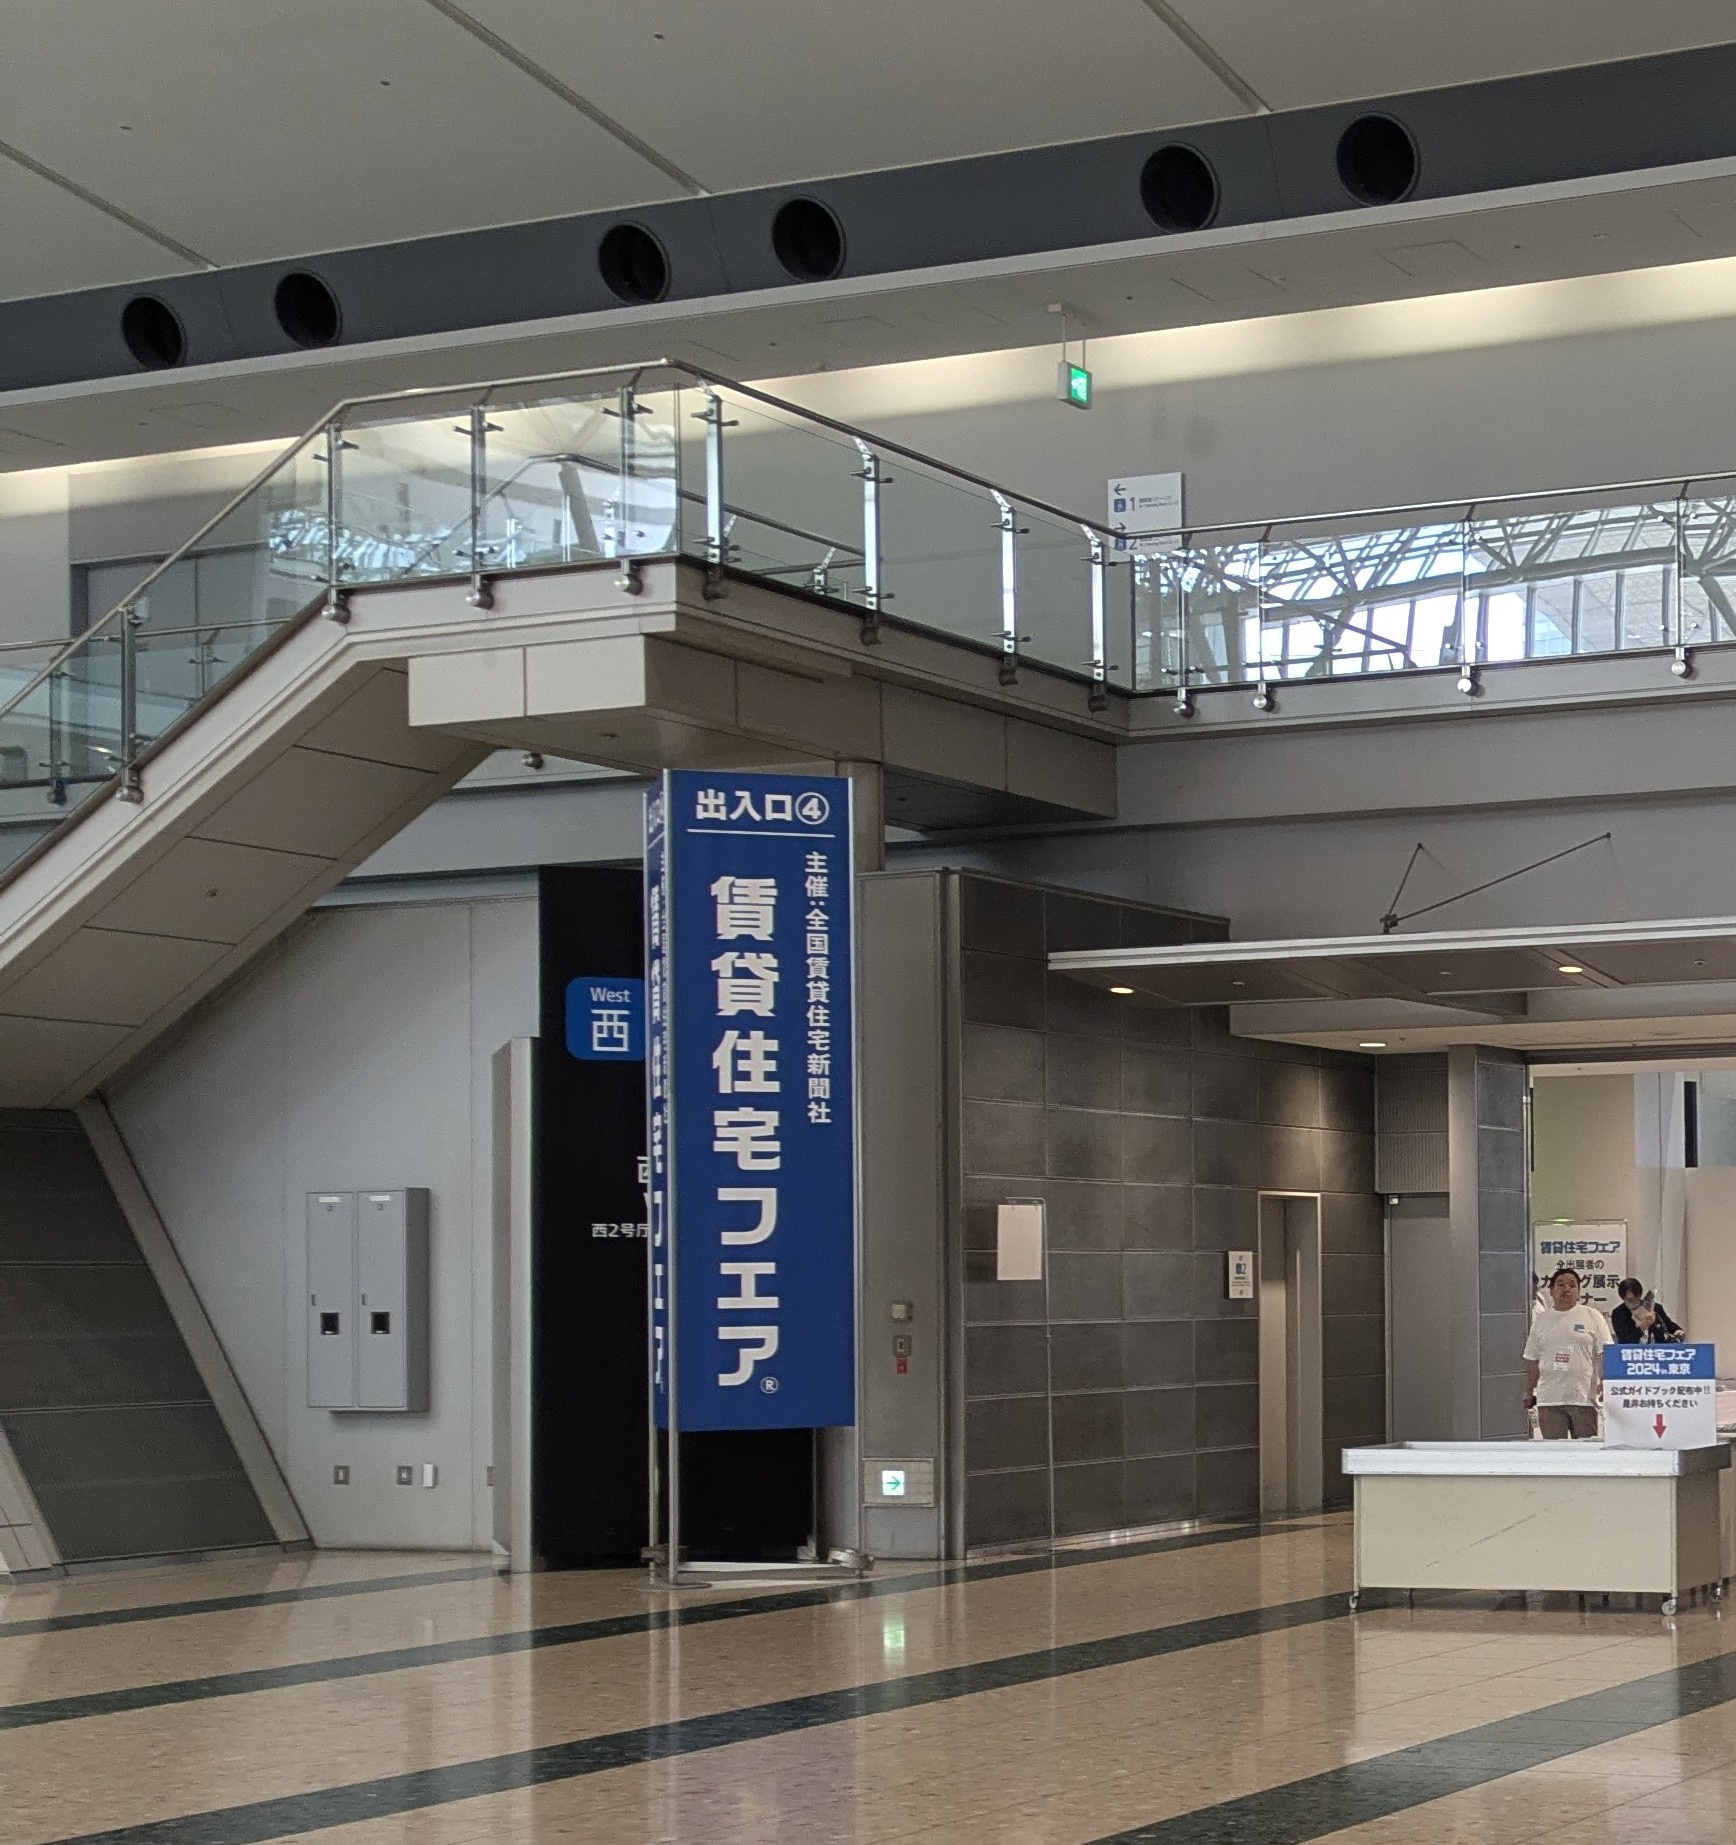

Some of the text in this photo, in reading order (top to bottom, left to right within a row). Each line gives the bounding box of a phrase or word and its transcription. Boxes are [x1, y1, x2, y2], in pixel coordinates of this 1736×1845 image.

[1129, 496, 1136, 511] 1
[694, 788, 831, 826] 出入口④
[589, 985, 631, 1004] West
[590, 1008, 630, 1054] 西
[1540, 1274, 1621, 1289] カグ展示
